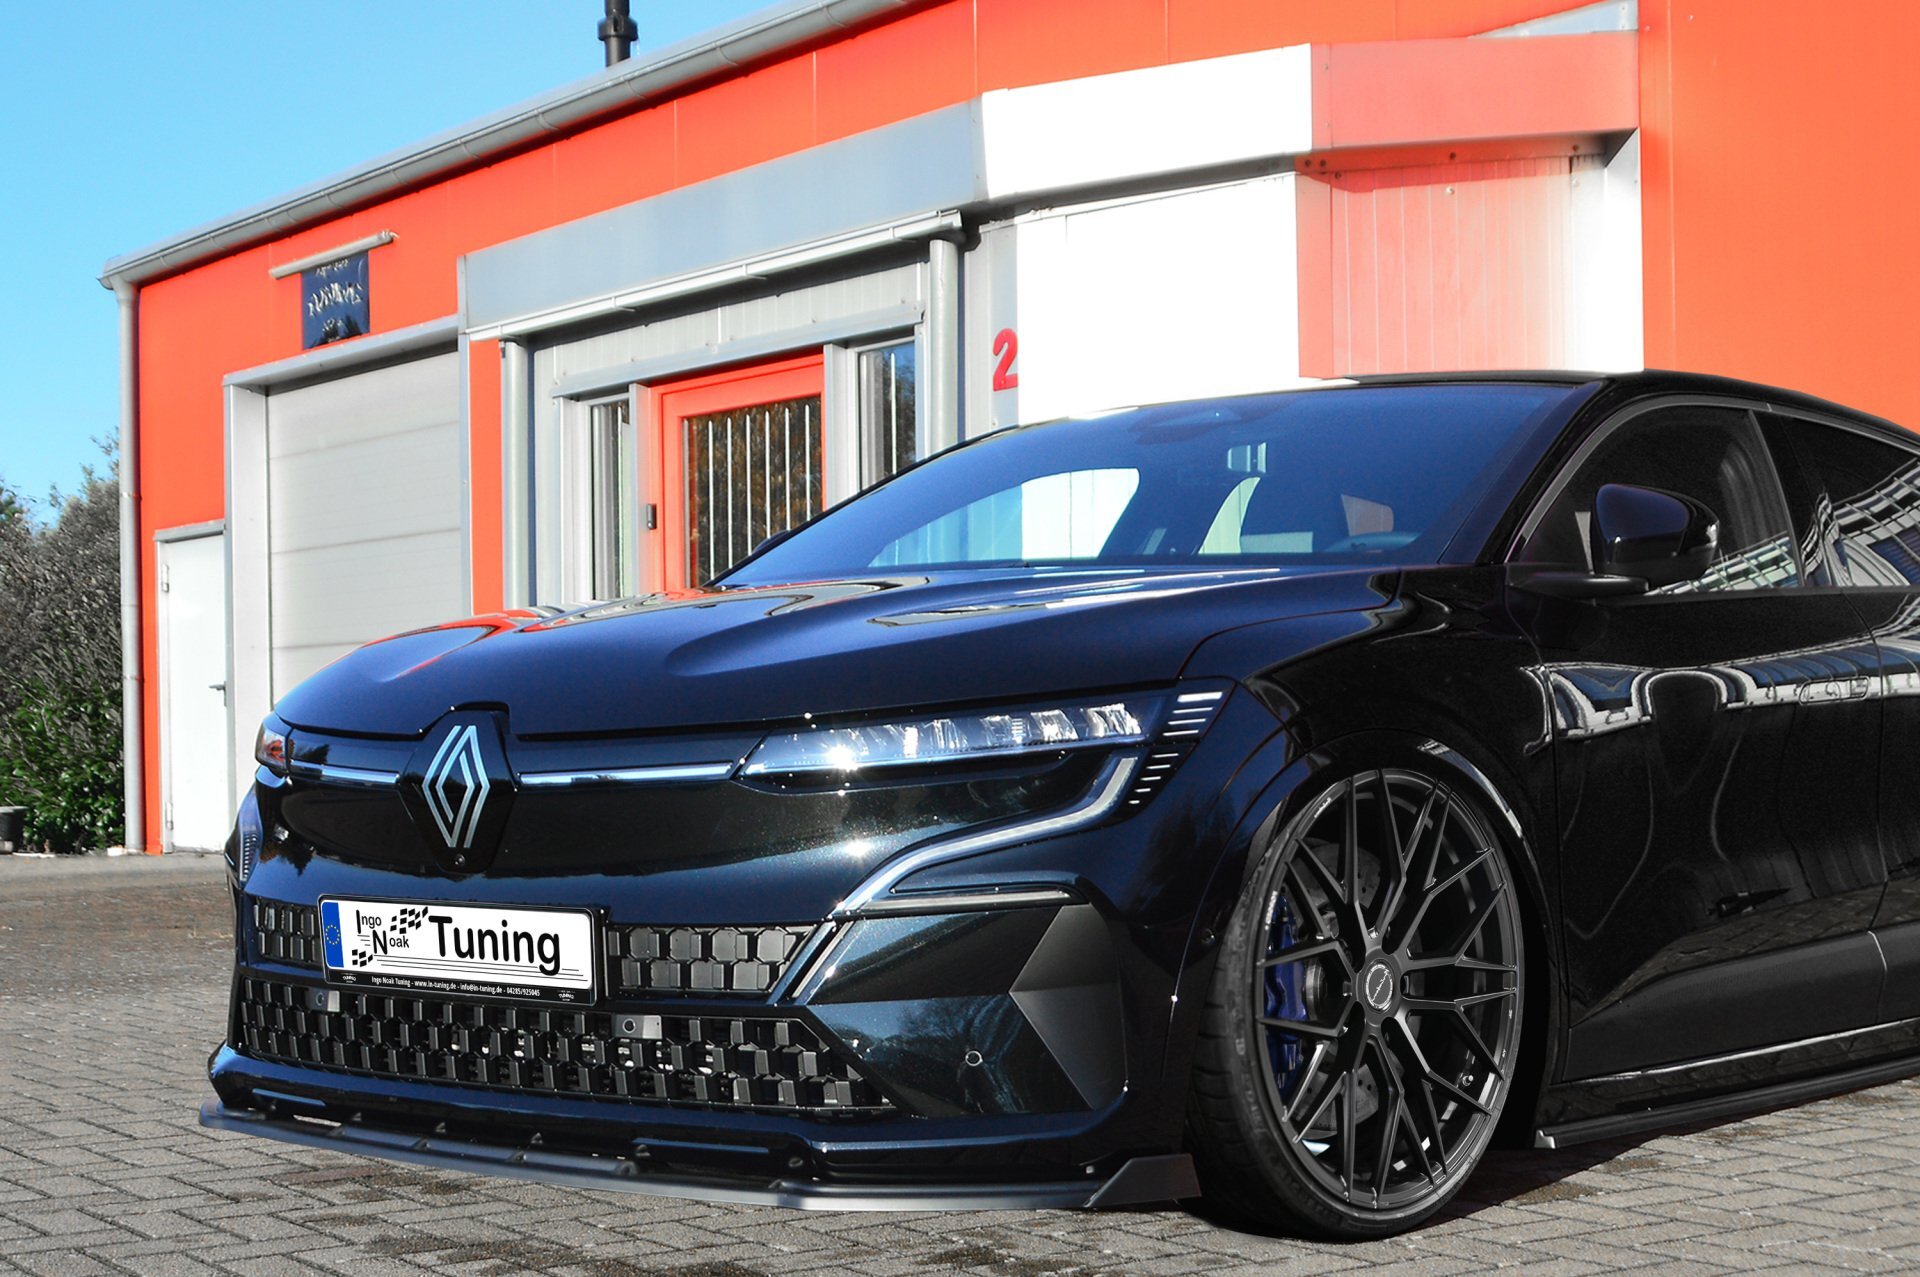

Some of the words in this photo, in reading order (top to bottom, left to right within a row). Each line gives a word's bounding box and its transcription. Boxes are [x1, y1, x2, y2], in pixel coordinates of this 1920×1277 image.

[993, 328, 1018, 392] 2
[356, 909, 382, 935] Ingo
[372, 929, 410, 955] Noak
[428, 915, 560, 976] Tuning
[371, 976, 382, 986] Ingo
[383, 976, 395, 985] Noak
[395, 978, 411, 987] Tuning
